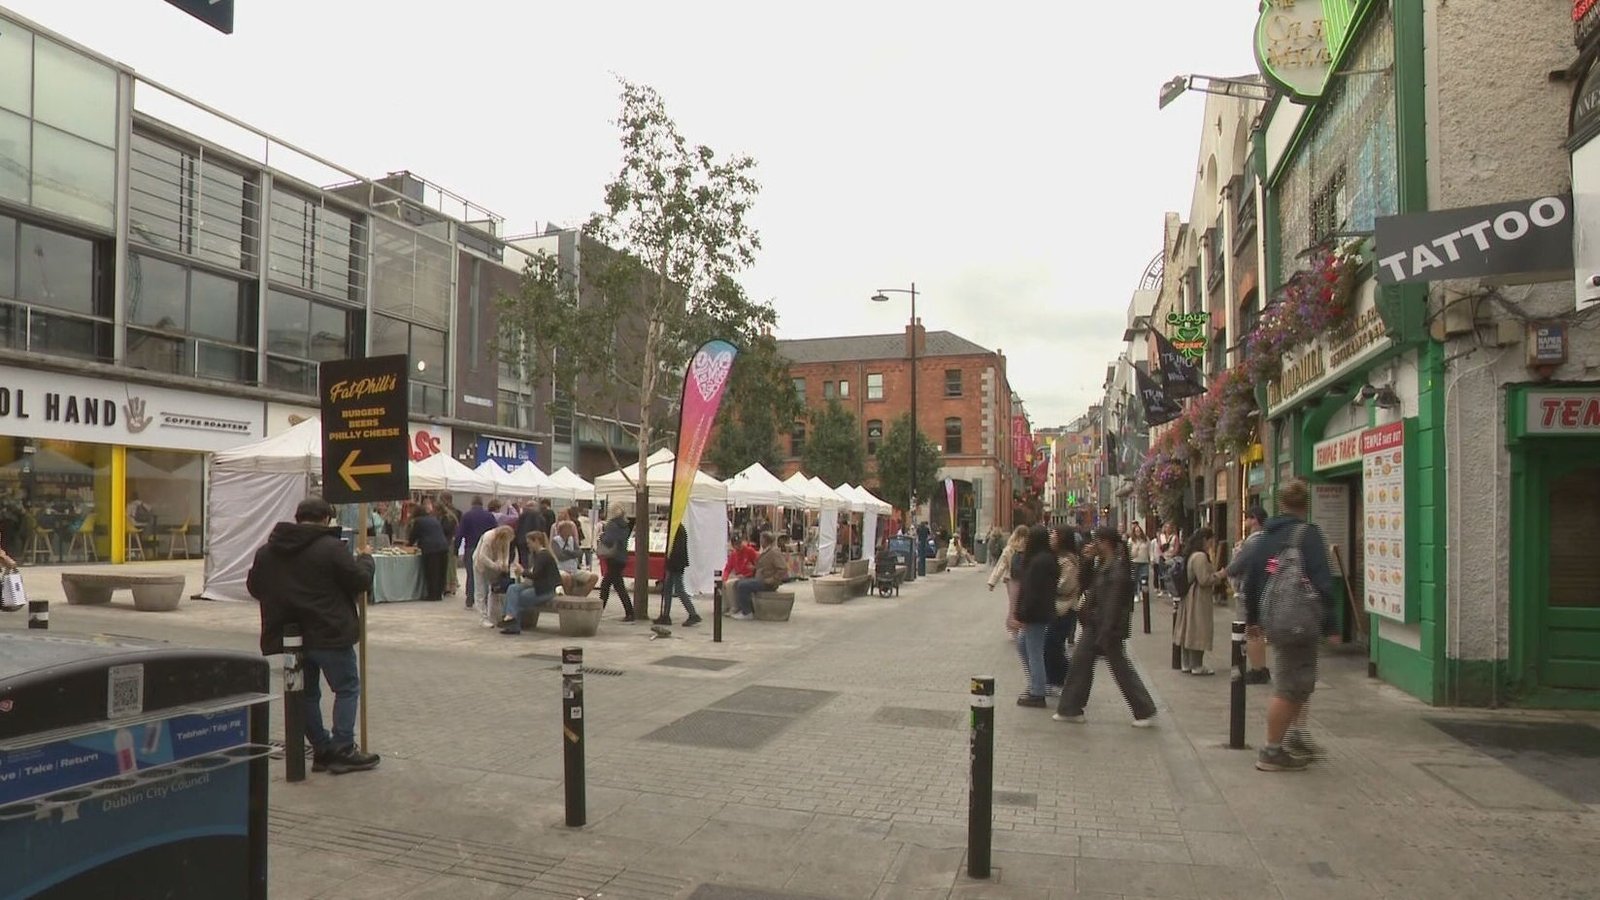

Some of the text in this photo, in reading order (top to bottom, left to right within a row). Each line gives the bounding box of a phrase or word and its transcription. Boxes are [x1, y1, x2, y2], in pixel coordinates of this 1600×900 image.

[1379, 197, 1566, 282] TATTOO
[1167, 311, 1210, 325] Quays
[45, 393, 116, 426] HAND
[342, 407, 386, 418] BURGERS
[165, 416, 248, 431] COFFEE ROASTERS
[349, 419, 379, 428] BEERS
[329, 428, 400, 440] PHILLY CHEESE
[1364, 431, 1382, 450] TEMPLE
[1382, 434, 1393, 444] TAKE
[1393, 430, 1402, 443] OUT
[486, 440, 518, 460] ATM
[1316, 441, 1338, 467] TEMPLE
[1339, 436, 1358, 459] TAKE
[24, 763, 54, 776] Take
[60, 752, 99, 768] Return
[102, 791, 144, 812] Dublin
[146, 784, 170, 800] City
[170, 773, 211, 793] Council
